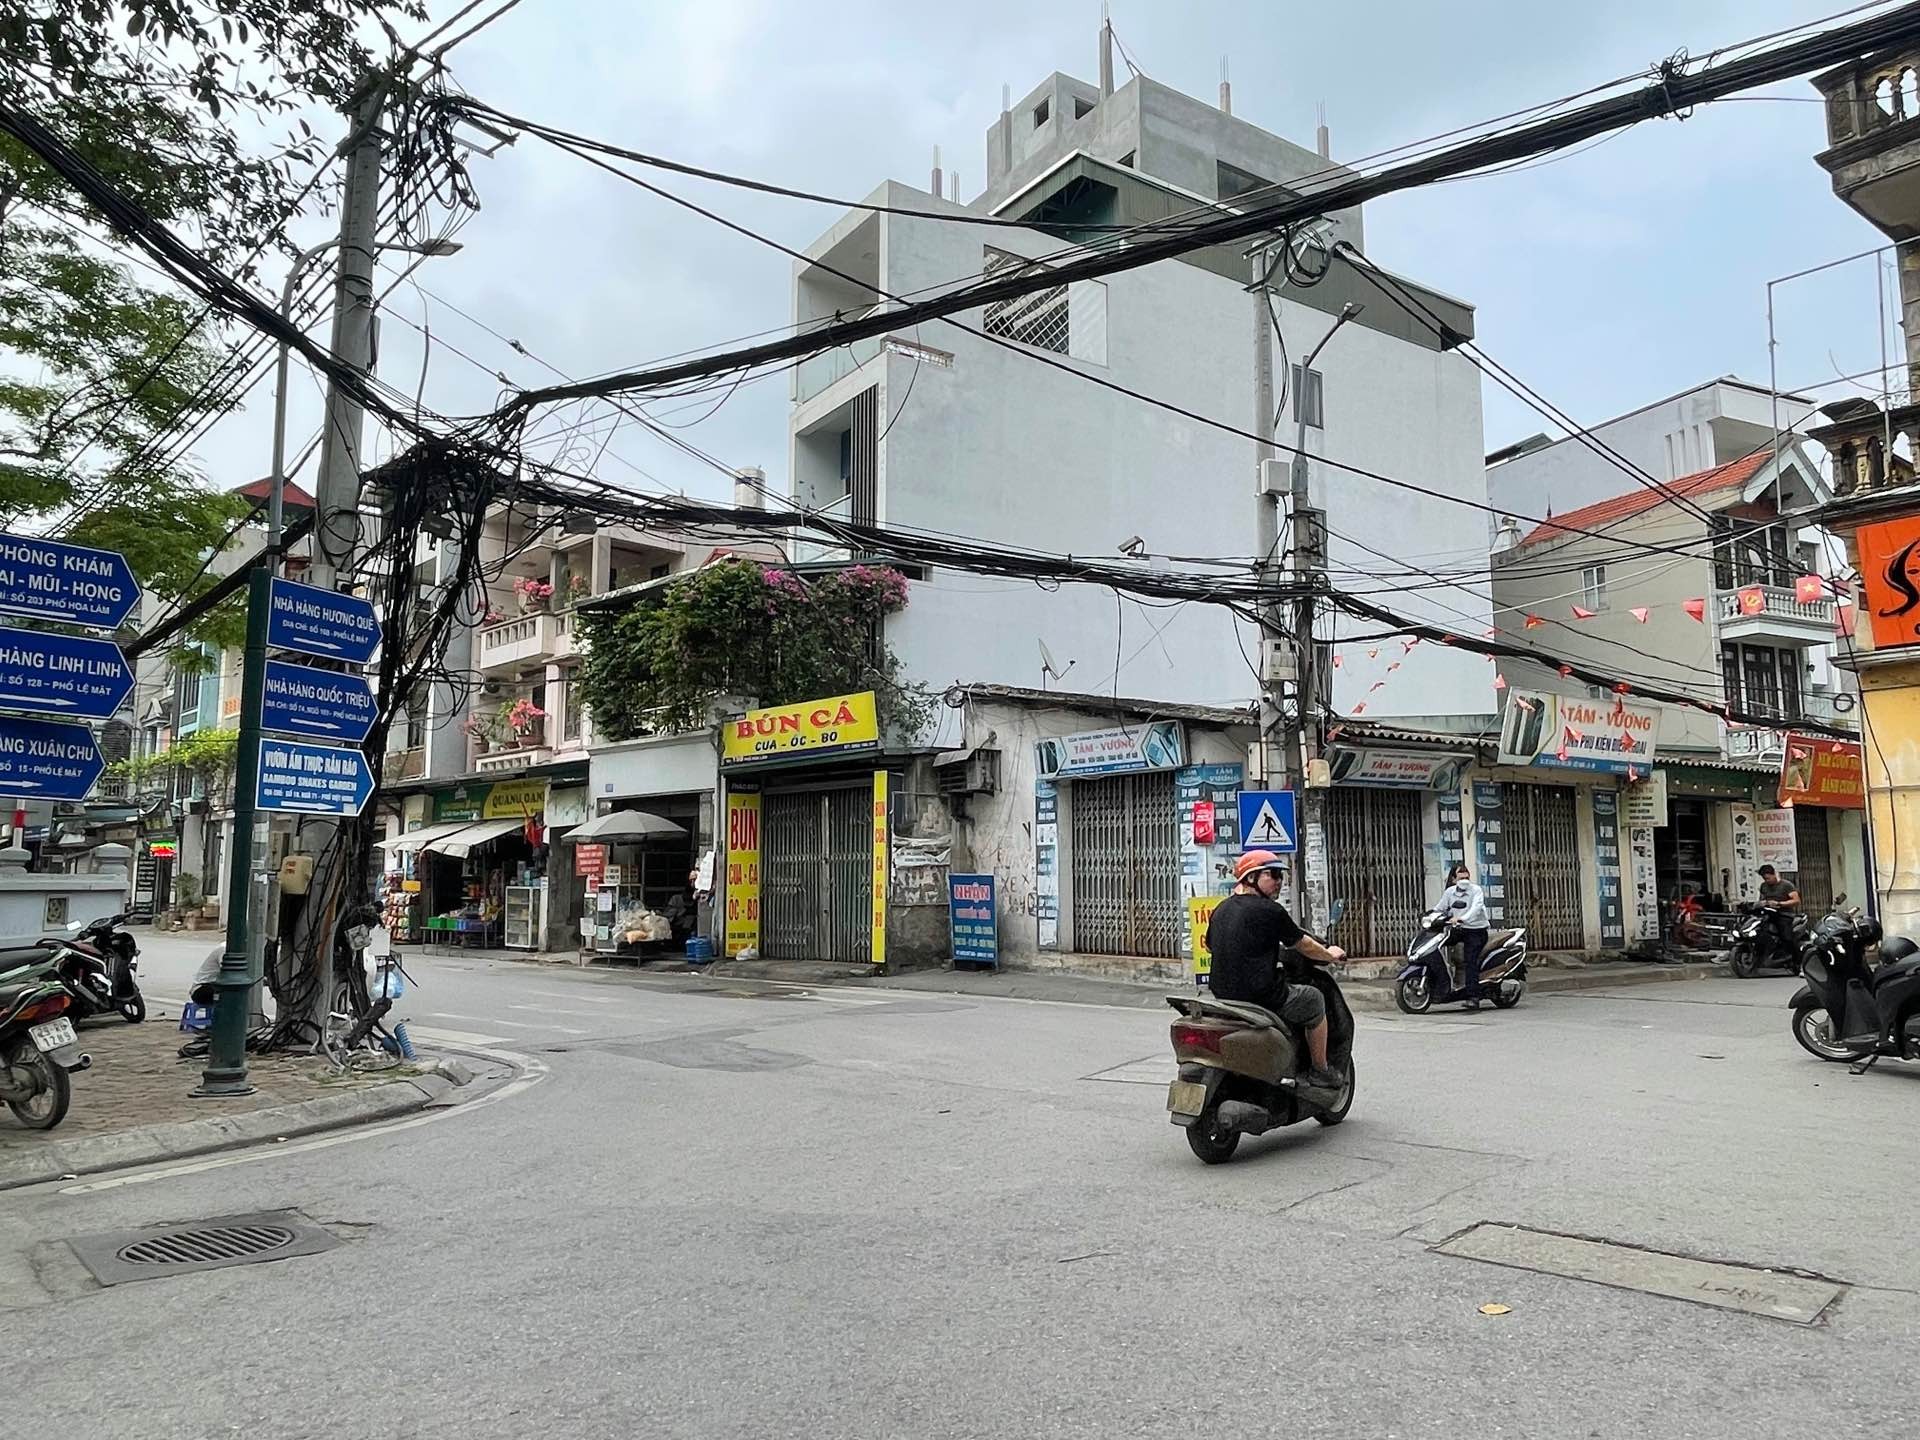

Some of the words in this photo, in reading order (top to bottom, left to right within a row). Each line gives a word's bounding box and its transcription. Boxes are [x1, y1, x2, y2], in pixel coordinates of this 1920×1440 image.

[63, 556, 113, 577] KHÁM
[28, 573, 60, 593] MŨI
[72, 581, 121, 602] HỌNG
[10, 592, 25, 603] SỐ
[27, 596, 43, 606] 203
[45, 597, 67, 608] PHỐ
[68, 602, 88, 611] HOA
[274, 595, 294, 610] NHÀ
[295, 600, 320, 618] HÀNG
[0, 646, 44, 668] HÀNG
[49, 654, 84, 673] LINH
[88, 660, 121, 679] LINH
[8, 672, 24, 685] SỐ
[27, 679, 42, 688] 128
[52, 680, 75, 691] PHỐ
[267, 678, 287, 694] NHÀ
[289, 681, 315, 699] HÀNG
[316, 685, 343, 704] QUỐC
[345, 691, 370, 709] TRIỆU
[737, 713, 801, 740] BÚN
[1568, 705, 1596, 724] TÂM
[1607, 710, 1651, 731] VƯƠNG
[28, 739, 65, 758] XUÂN
[67, 745, 94, 760] CHU
[755, 740, 777, 751] CUA
[1074, 743, 1093, 755] TÂM
[954, 882, 990, 903] NHẬN
